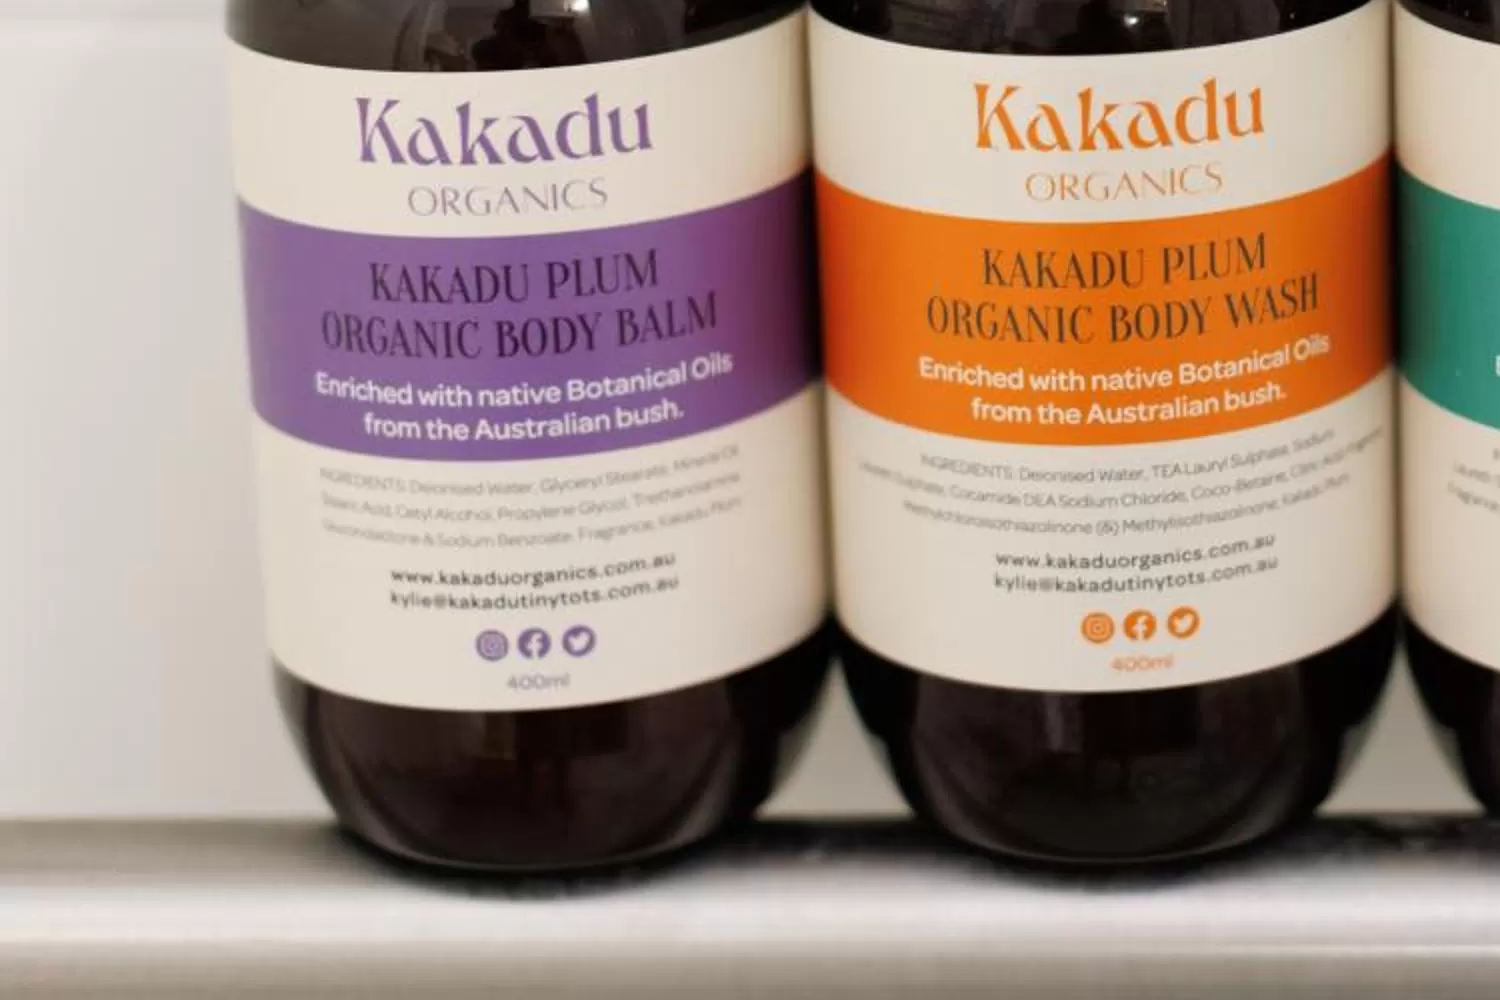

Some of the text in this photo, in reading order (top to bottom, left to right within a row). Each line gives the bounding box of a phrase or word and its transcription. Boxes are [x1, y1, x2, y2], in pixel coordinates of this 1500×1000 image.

[356, 92, 654, 167] Kakadu
[974, 77, 1264, 152] Kakadu
[408, 176, 608, 217] ORGANICS
[1025, 163, 1223, 203] ORGANICS
[370, 249, 659, 305] KAKADU PLUM
[982, 232, 1266, 289] KAKADU PLUM
[321, 291, 718, 360] ORGANIC BODY BALM
[927, 272, 1318, 344] ORGANIC BODY WASH
[315, 350, 733, 410] Enriched with native Botanical Oils
[920, 334, 1329, 391] Enriched with native Botanical Oils
[364, 399, 685, 442] from the Australian bush.
[971, 381, 1286, 425] from the Australian bush.
[391, 553, 676, 588] www.kakaduorganics.com.au
[995, 534, 1276, 570] www.kakaduorganics.com.au
[390, 576, 679, 611] kylie@kakadutinytots.com.au
[994, 556, 1278, 594] kylie@kakadutinytots.com.au
[507, 673, 571, 691] 400ml
[1111, 654, 1175, 673] 400ml
